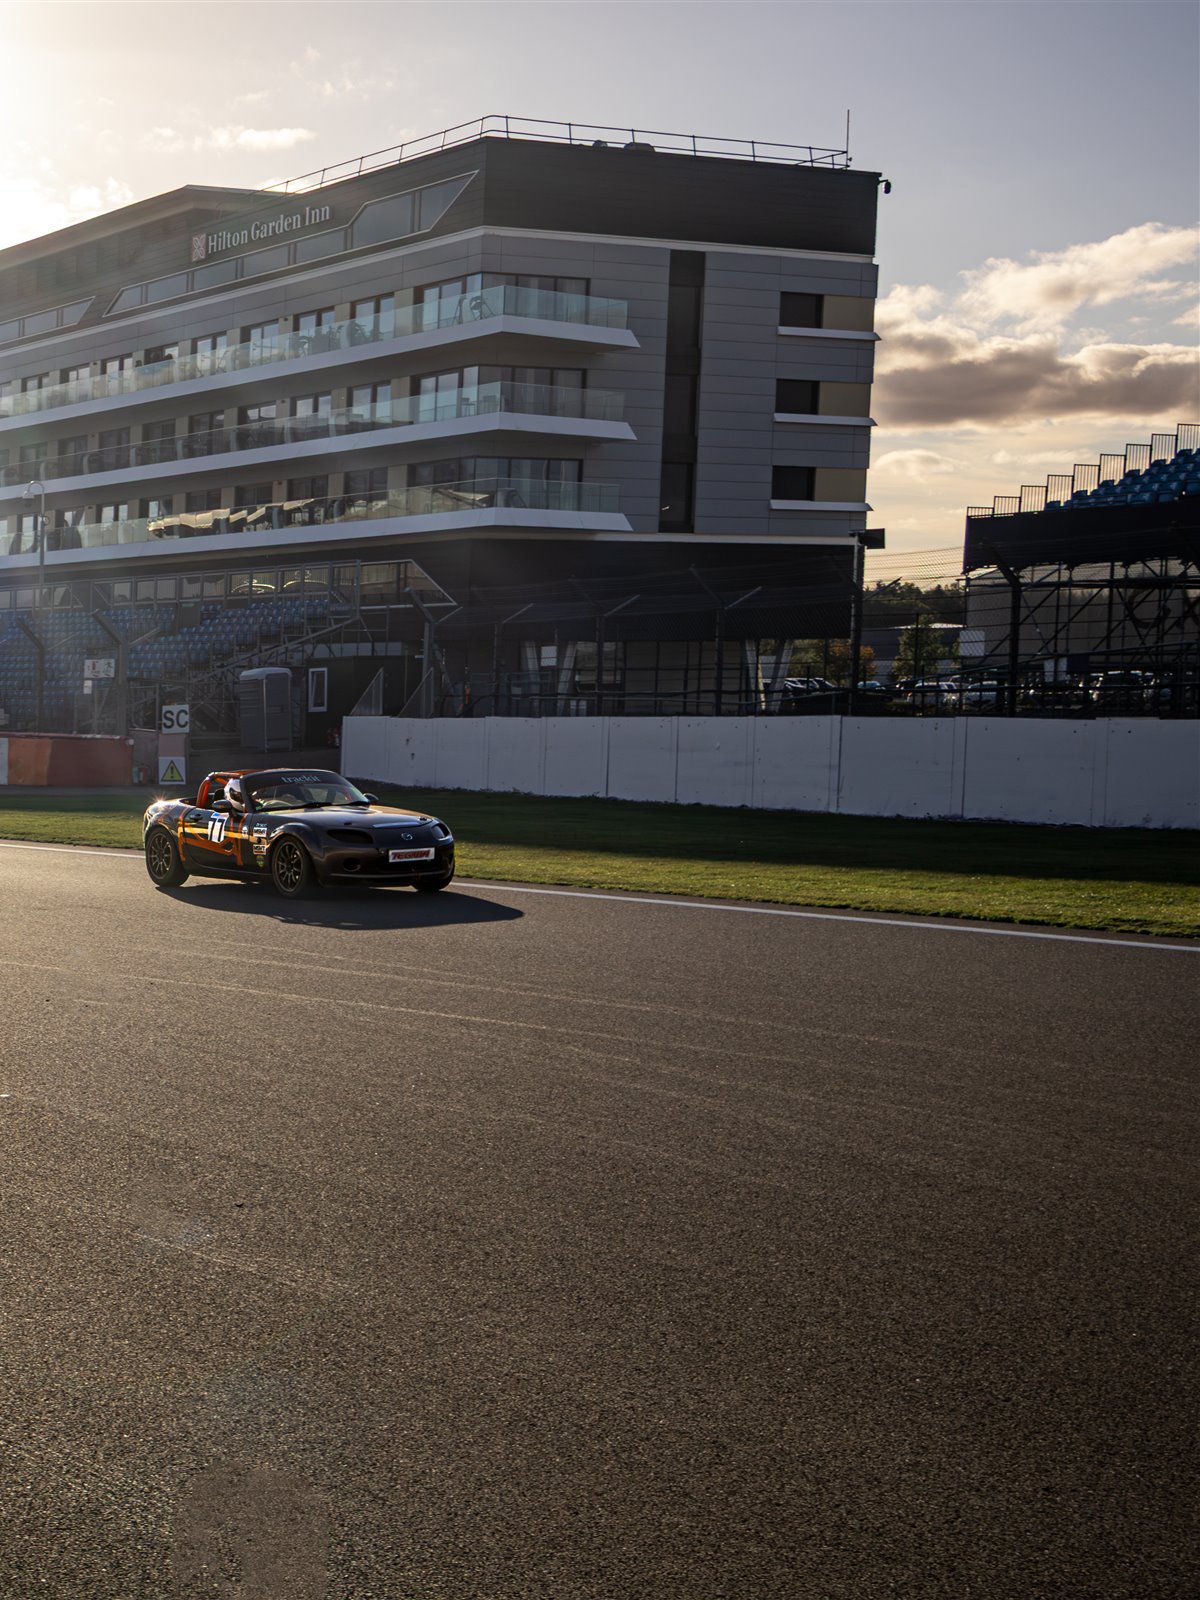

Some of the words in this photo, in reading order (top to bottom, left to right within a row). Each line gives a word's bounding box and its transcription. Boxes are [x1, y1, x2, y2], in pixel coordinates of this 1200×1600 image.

[208, 229, 248, 254] Hilton
[250, 213, 301, 241] Garden
[305, 205, 330, 226] Inn
[163, 709, 188, 728] SC
[210, 818, 226, 842] 77
